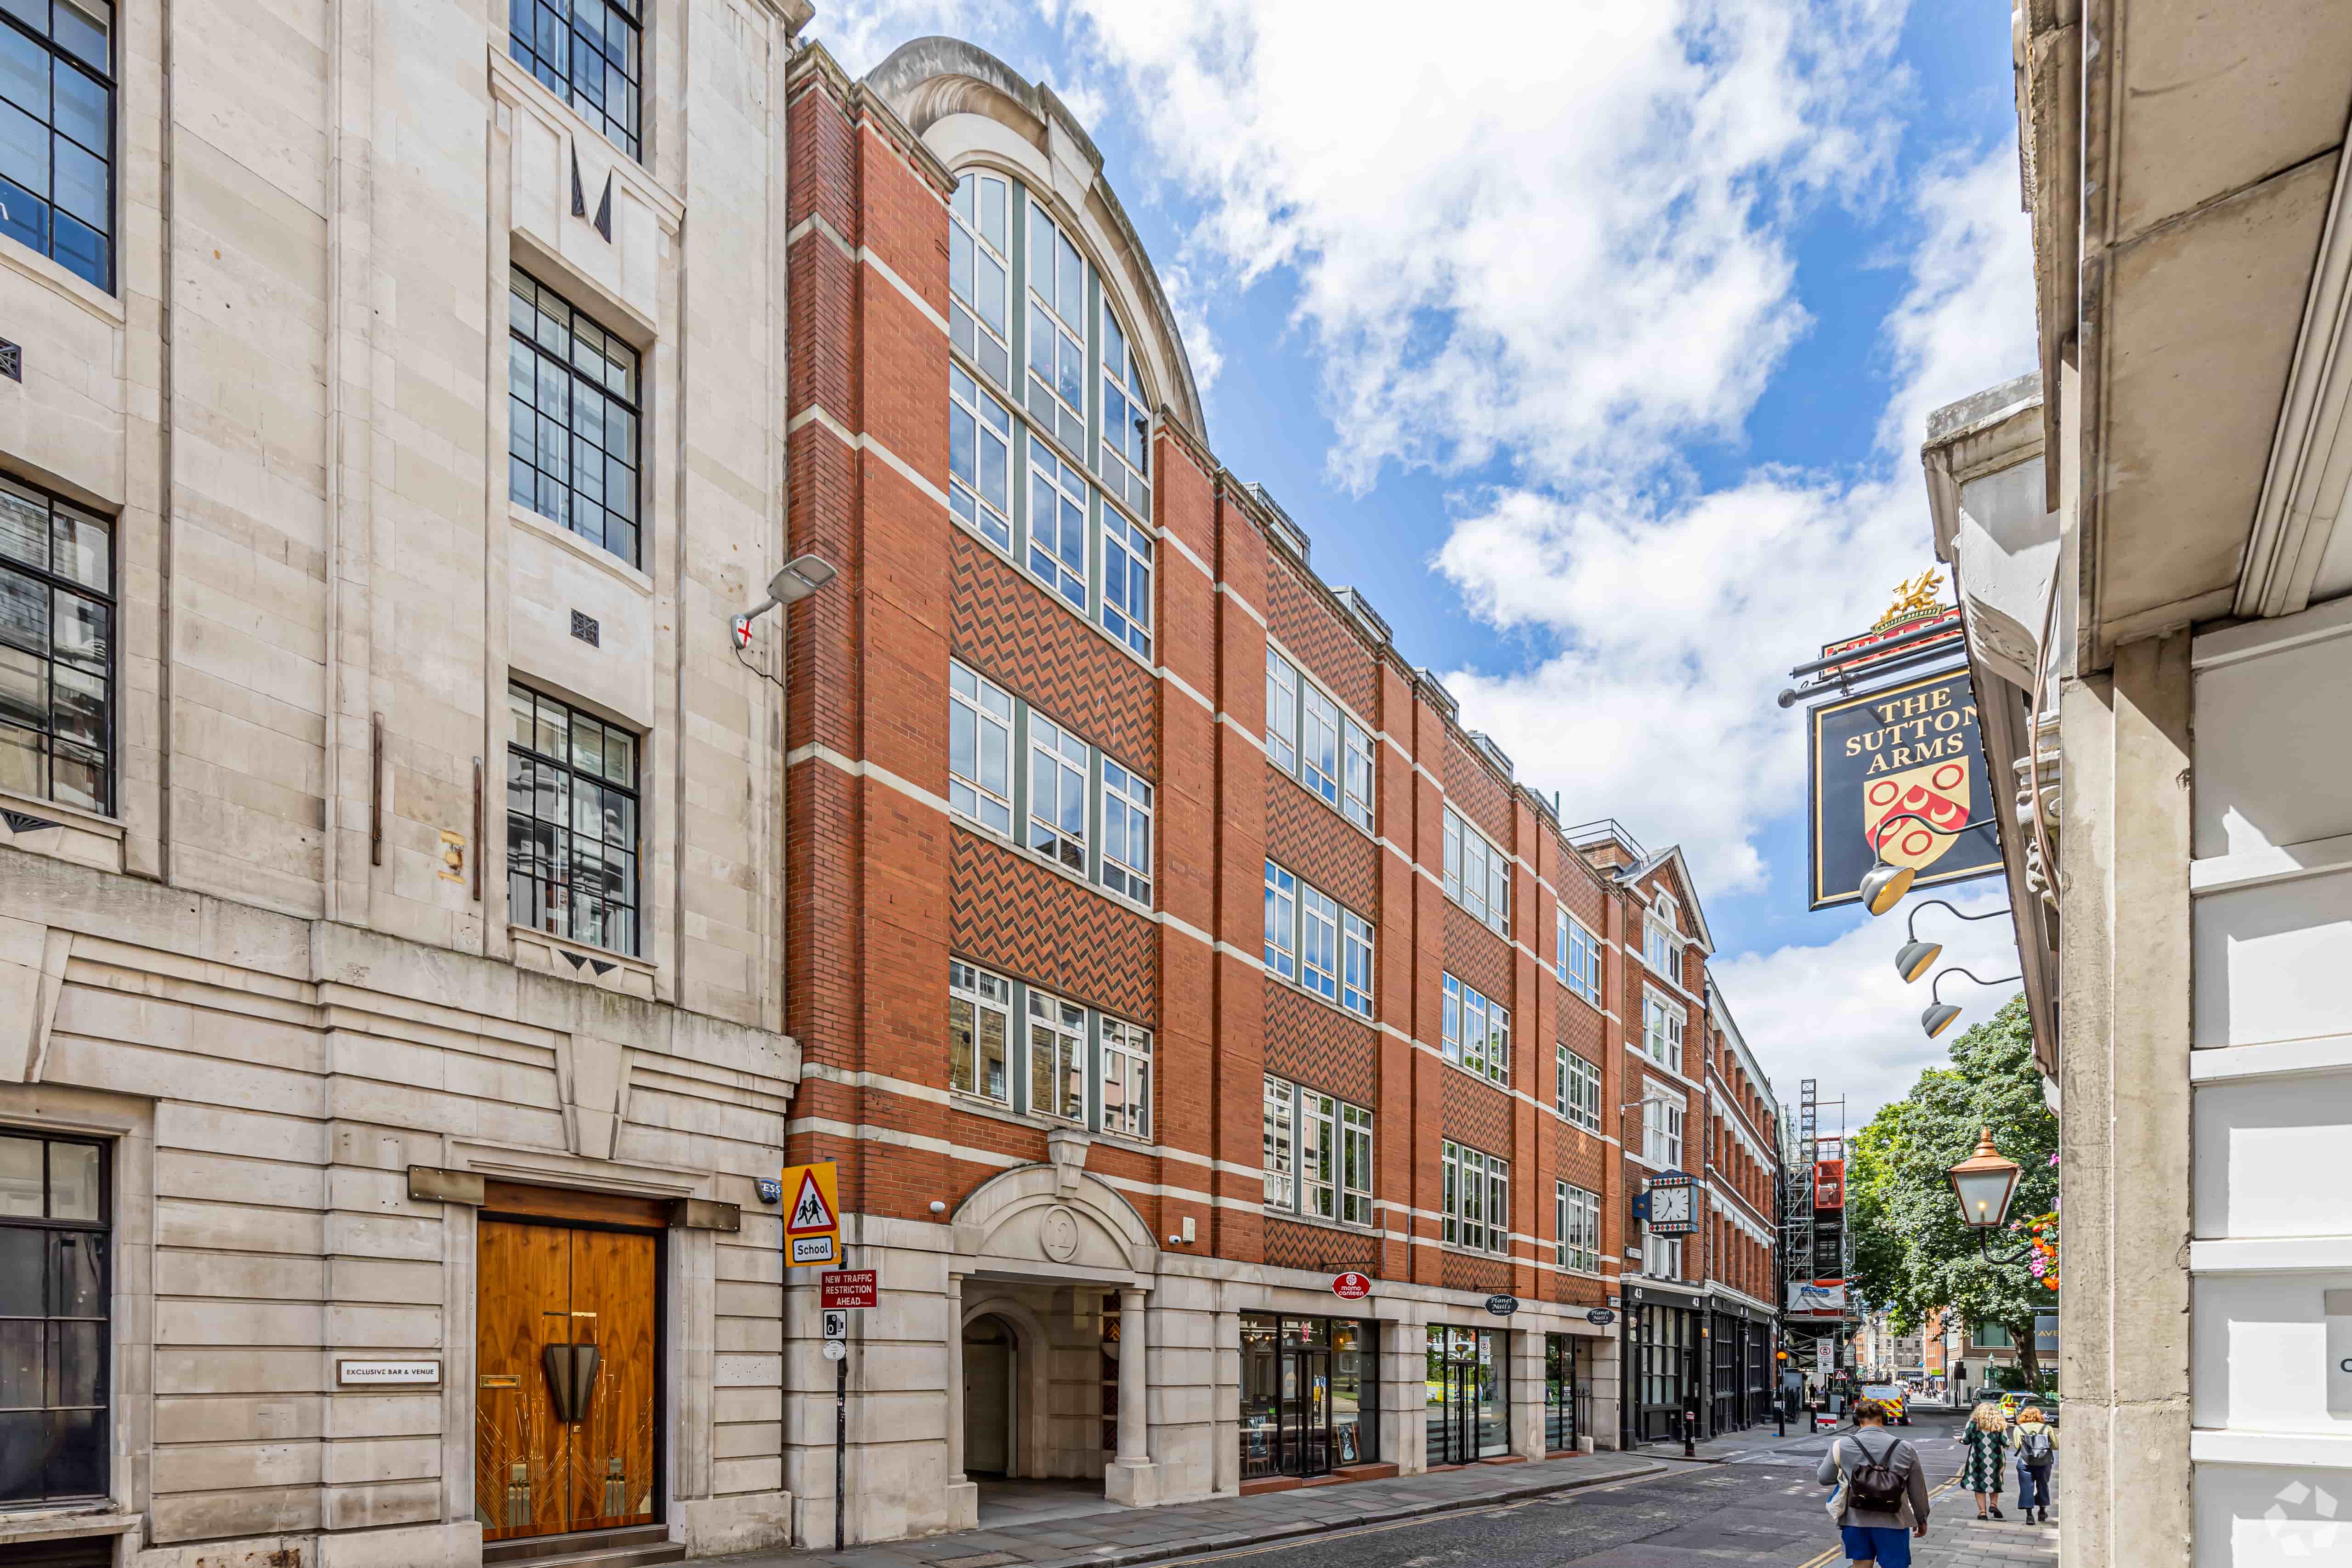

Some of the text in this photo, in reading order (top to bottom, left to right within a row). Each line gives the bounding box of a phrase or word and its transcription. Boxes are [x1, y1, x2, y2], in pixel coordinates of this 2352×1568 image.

[1878, 687, 1952, 723] THE
[1846, 706, 1978, 757] SUTTON
[1866, 732, 1963, 775] ARMS
[798, 1243, 828, 1255] School
[843, 1274, 873, 1283] TRAFFIC
[826, 1285, 872, 1294] RESTRICTION
[1634, 1288, 1642, 1299] 43
[836, 1297, 861, 1305] AHEAD
[1692, 1297, 1699, 1308] 43
